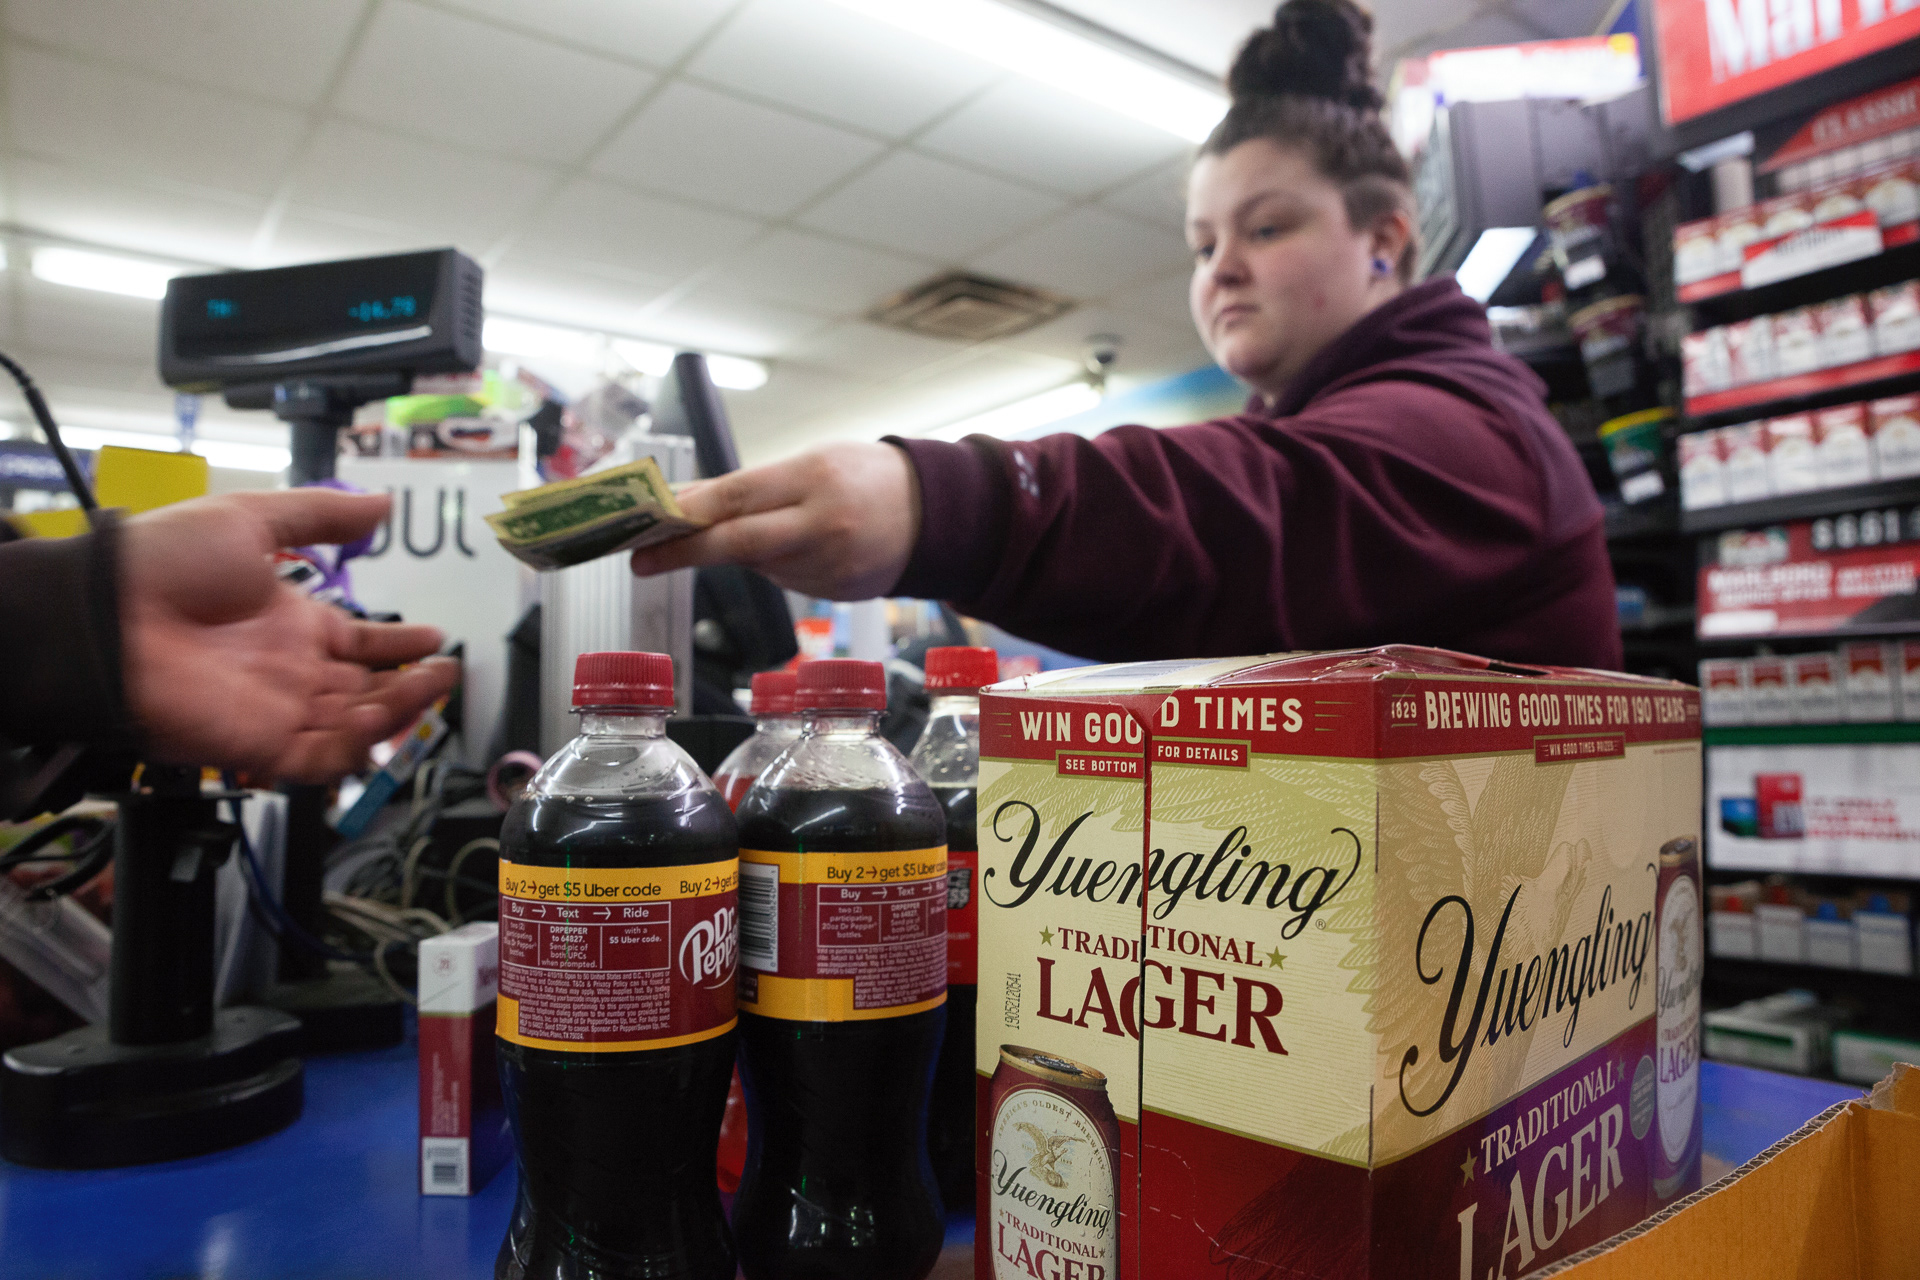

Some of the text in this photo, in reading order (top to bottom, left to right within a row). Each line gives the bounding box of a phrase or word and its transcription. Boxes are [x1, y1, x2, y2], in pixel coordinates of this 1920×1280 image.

[1703, 0, 1920, 86] Mar
[1020, 711, 1071, 742] WIN
[1195, 696, 1303, 733] TIMES
[1391, 701, 1417, 719] 1829
[1424, 691, 1512, 729] BREWING
[1518, 693, 1560, 727] GOOD
[1564, 694, 1603, 726] TIMES
[1606, 695, 1629, 724] FOR
[1632, 696, 1652, 723] 190
[1653, 696, 1686, 724] YEARS
[1065, 745, 1239, 773] SEE BOTTOM FOR DETAILS
[1563, 742, 1577, 755] GOOD
[1579, 741, 1595, 754] TIMES
[828, 867, 852, 882] Buy
[856, 867, 864, 878] 2
[880, 865, 900, 881] get
[903, 863, 915, 877] $5
[918, 864, 935, 875] Uber
[983, 800, 1361, 940] Yuengling
[505, 877, 661, 898] Buy 2 get $5 Uber code
[681, 881, 702, 896] Buy
[705, 878, 711, 891] 2
[841, 889, 861, 901] Buy
[898, 887, 914, 896] Text
[512, 902, 649, 918] Buy Text Ride
[830, 914, 872, 922] participating
[550, 926, 587, 935] DRPEPPER
[561, 935, 585, 943] 64827.
[679, 906, 738, 985] Dr Peppe
[1058, 924, 1263, 968] TRADITIONAL
[560, 960, 597, 968] prompted.
[566, 943, 578, 952] pic
[568, 952, 586, 960] UPCs
[1036, 956, 1289, 1056] LAGER
[1400, 862, 1658, 1117] Yuengling
[1480, 1059, 1615, 1175] TRADITIONAL
[1032, 1100, 1072, 1120] OLDEST
[1075, 1120, 1106, 1169] BREWERY
[991, 1149, 1114, 1239] Yuengling
[1456, 1102, 1624, 1280] LAGER
[1006, 1210, 1099, 1259] TRADITIONAL
